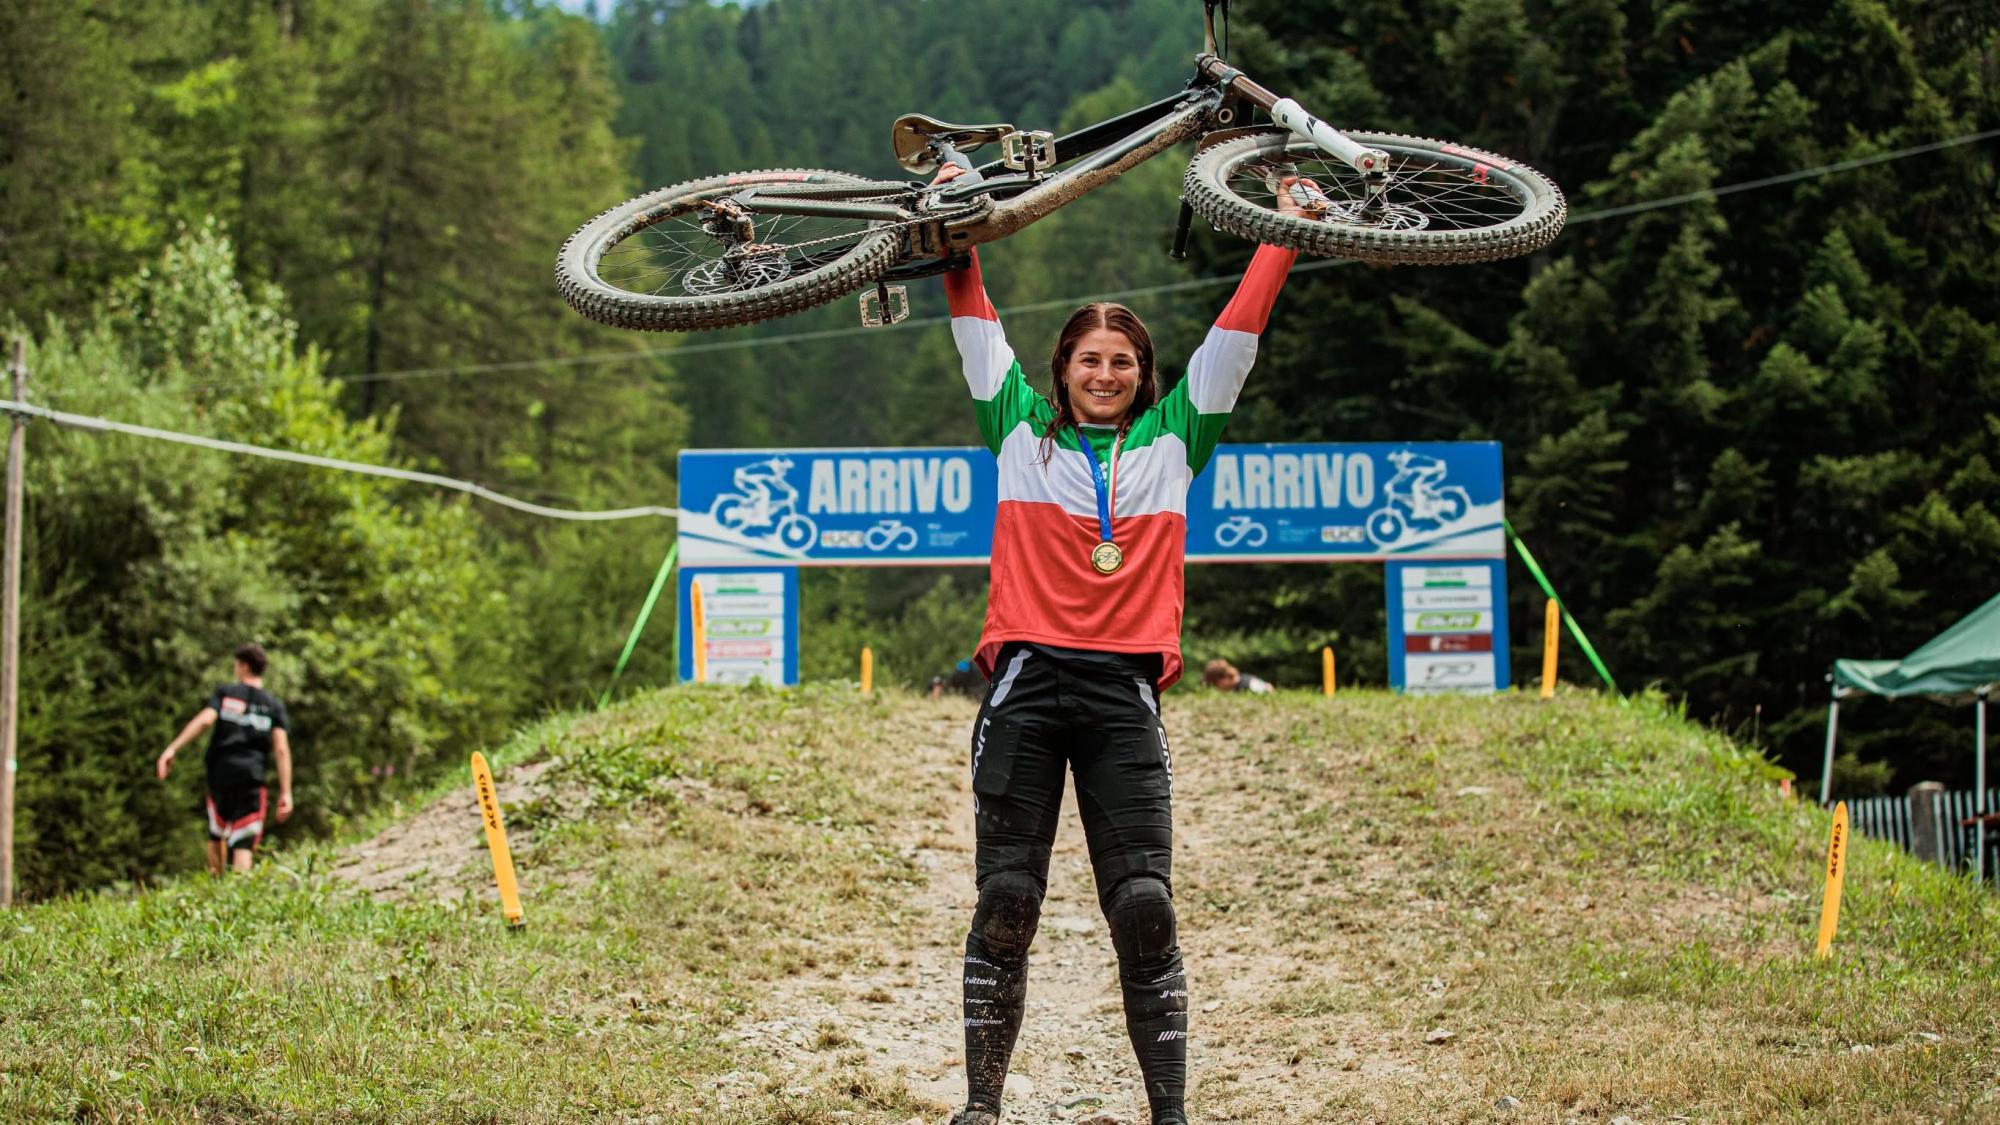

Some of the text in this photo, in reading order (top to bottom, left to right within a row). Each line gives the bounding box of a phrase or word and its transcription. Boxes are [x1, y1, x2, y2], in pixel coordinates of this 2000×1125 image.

[808, 458, 972, 515] ARRIVO
[1212, 452, 1376, 510] ARRIVO
[479, 773, 498, 830] ACERBIS
[1830, 822, 1842, 878] ACERBIS
